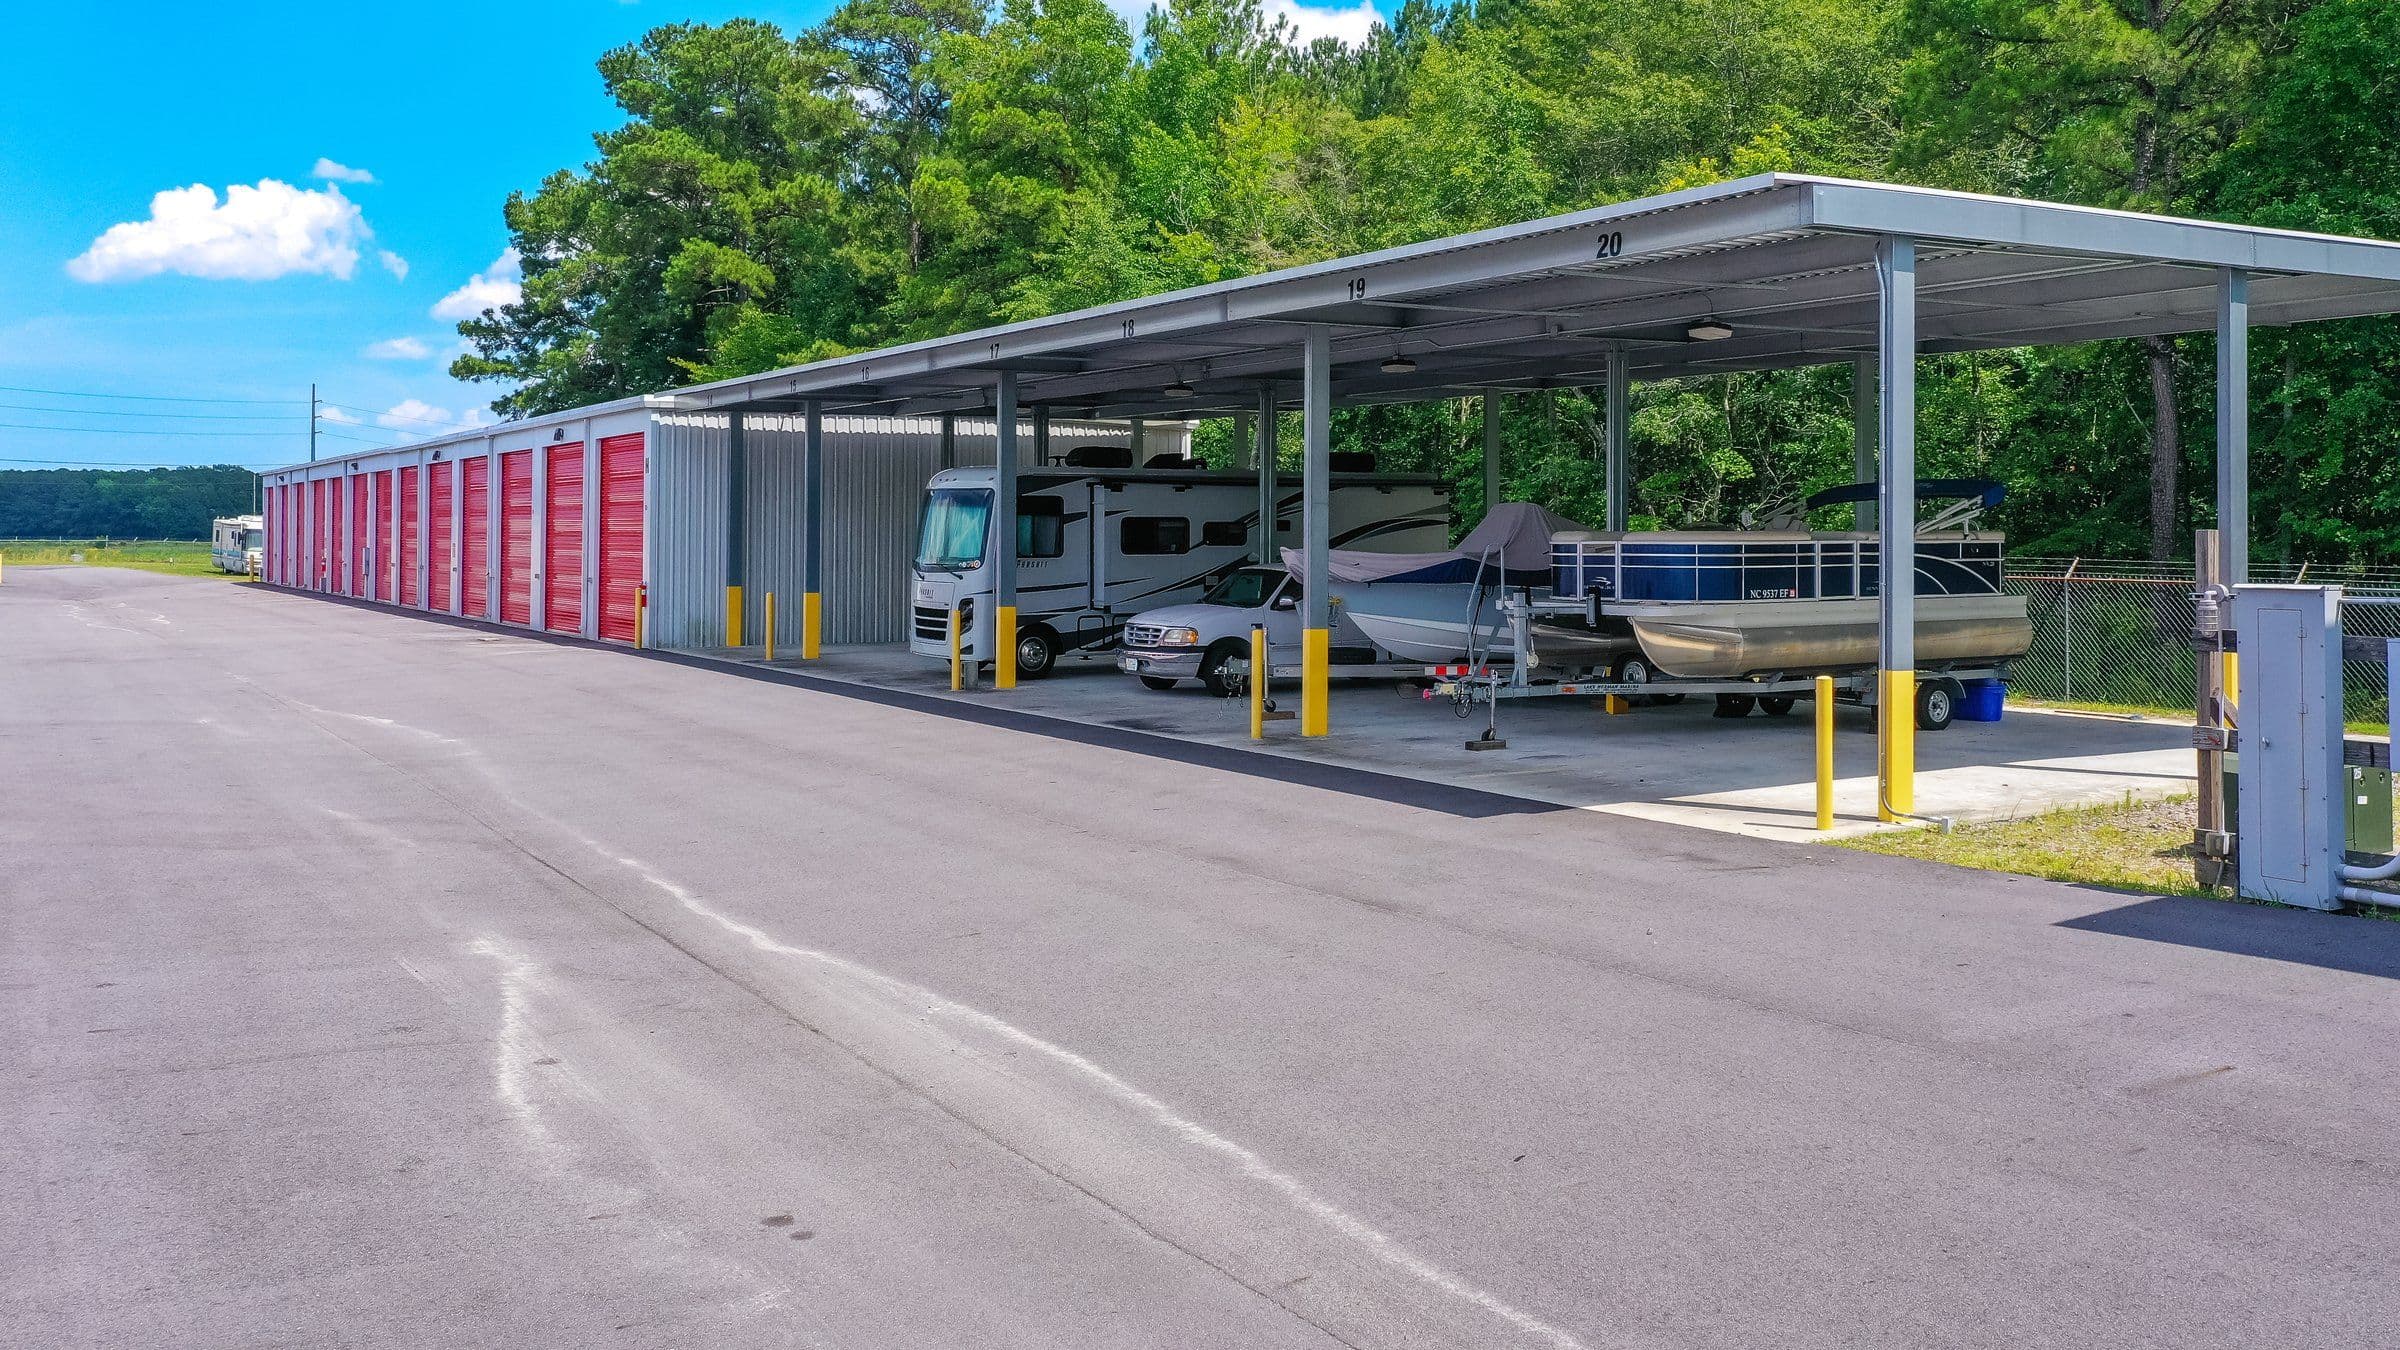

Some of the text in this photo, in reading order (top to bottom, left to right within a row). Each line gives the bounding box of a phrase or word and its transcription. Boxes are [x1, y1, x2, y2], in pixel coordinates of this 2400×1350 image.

[1596, 231, 1622, 259] 20
[1347, 277, 1366, 300] 19
[1121, 319, 1135, 338] 18
[989, 343, 1000, 360] 17
[861, 366, 870, 381] 16
[789, 379, 797, 393] 15
[1750, 588, 1789, 599] NC 9537 EF
